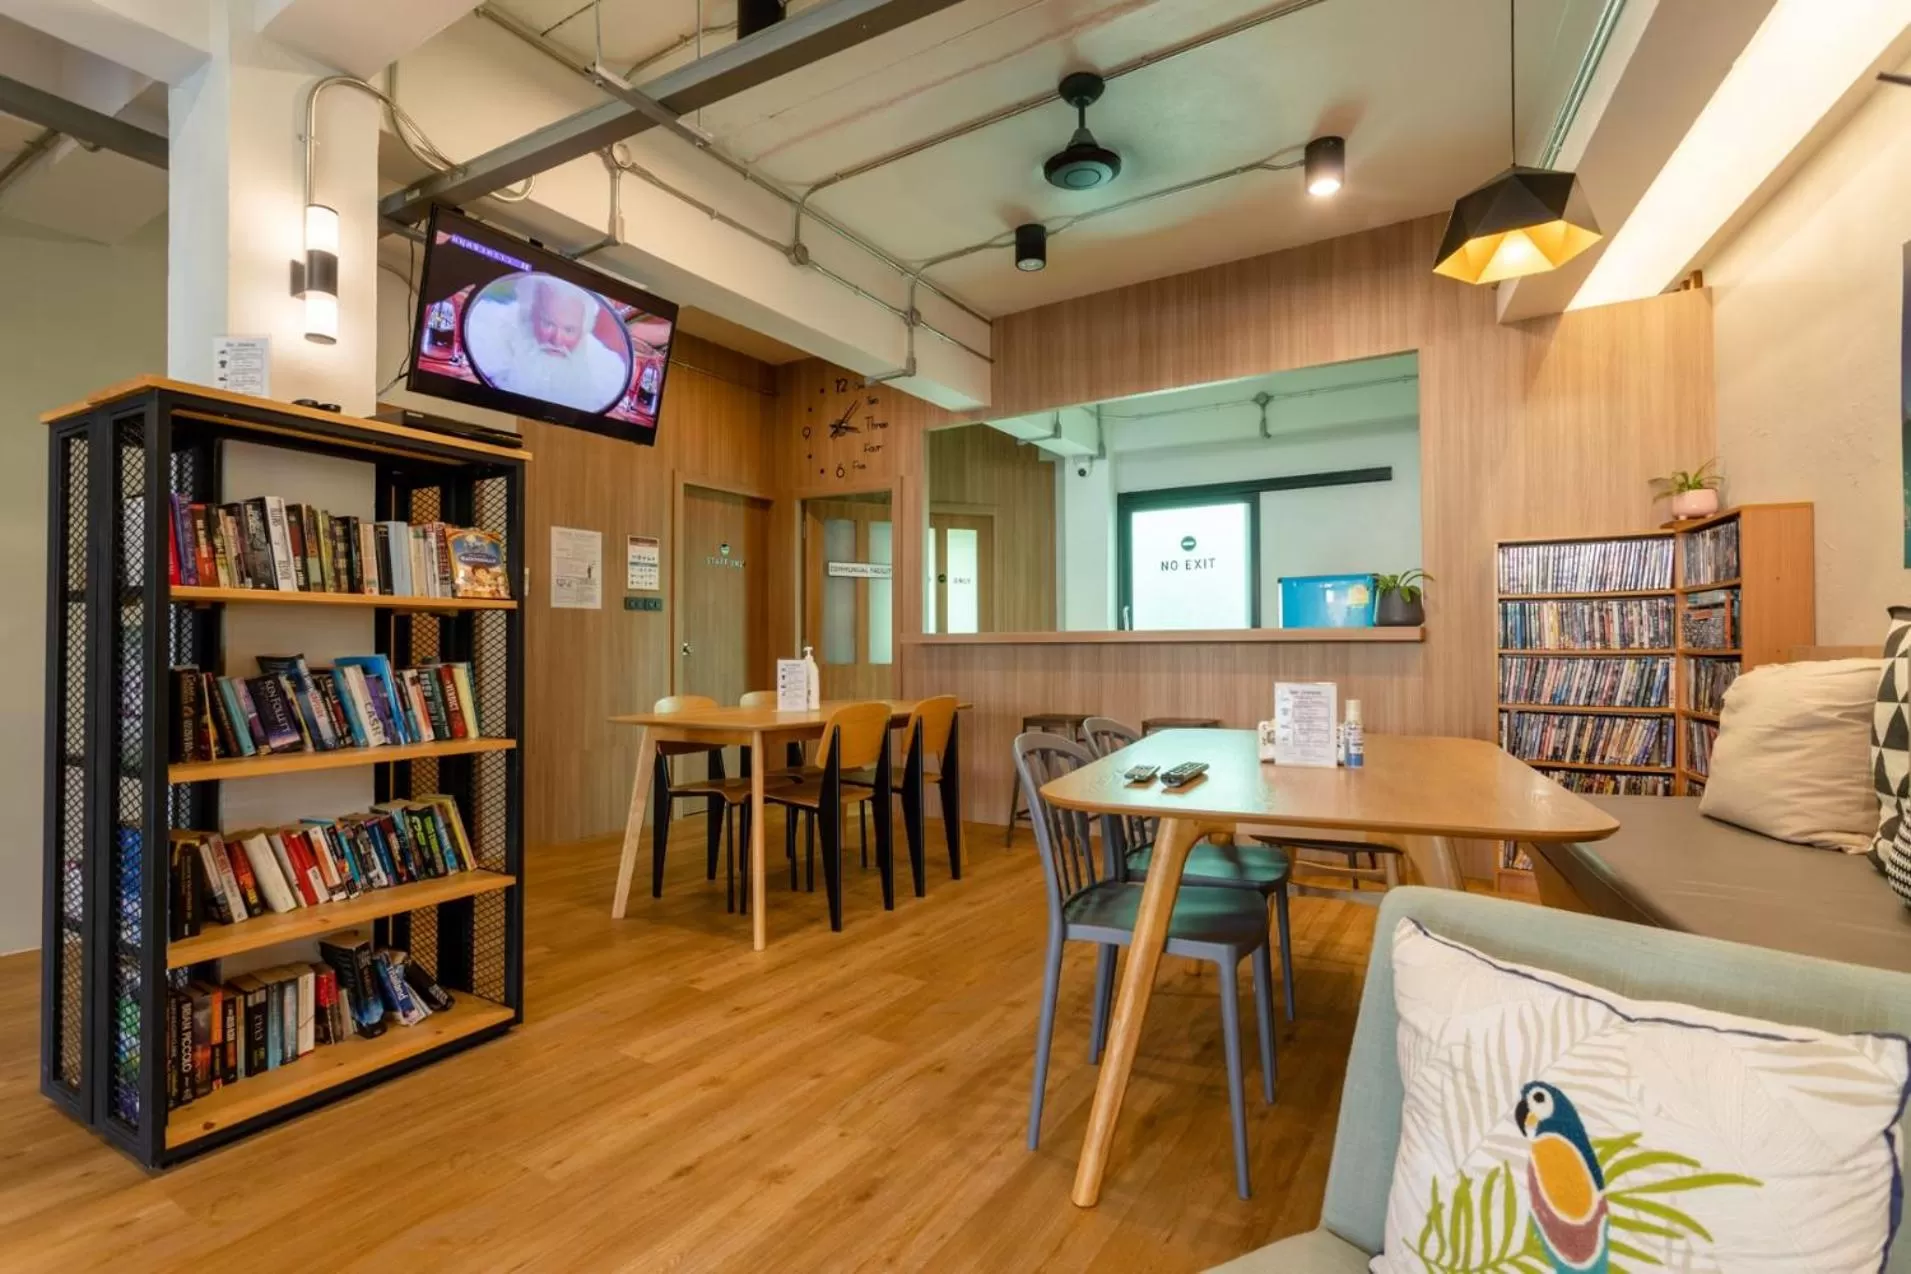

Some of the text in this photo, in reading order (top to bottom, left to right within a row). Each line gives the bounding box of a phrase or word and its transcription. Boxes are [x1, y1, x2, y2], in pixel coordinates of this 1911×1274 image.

[836, 378, 848, 393] 12
[865, 416, 889, 432] Three
[802, 426, 811, 440] 9
[836, 464, 845, 478] 6
[1160, 557, 1216, 571] NO EXIT
[182, 1002, 193, 1073] BRIAN PICCOLO
